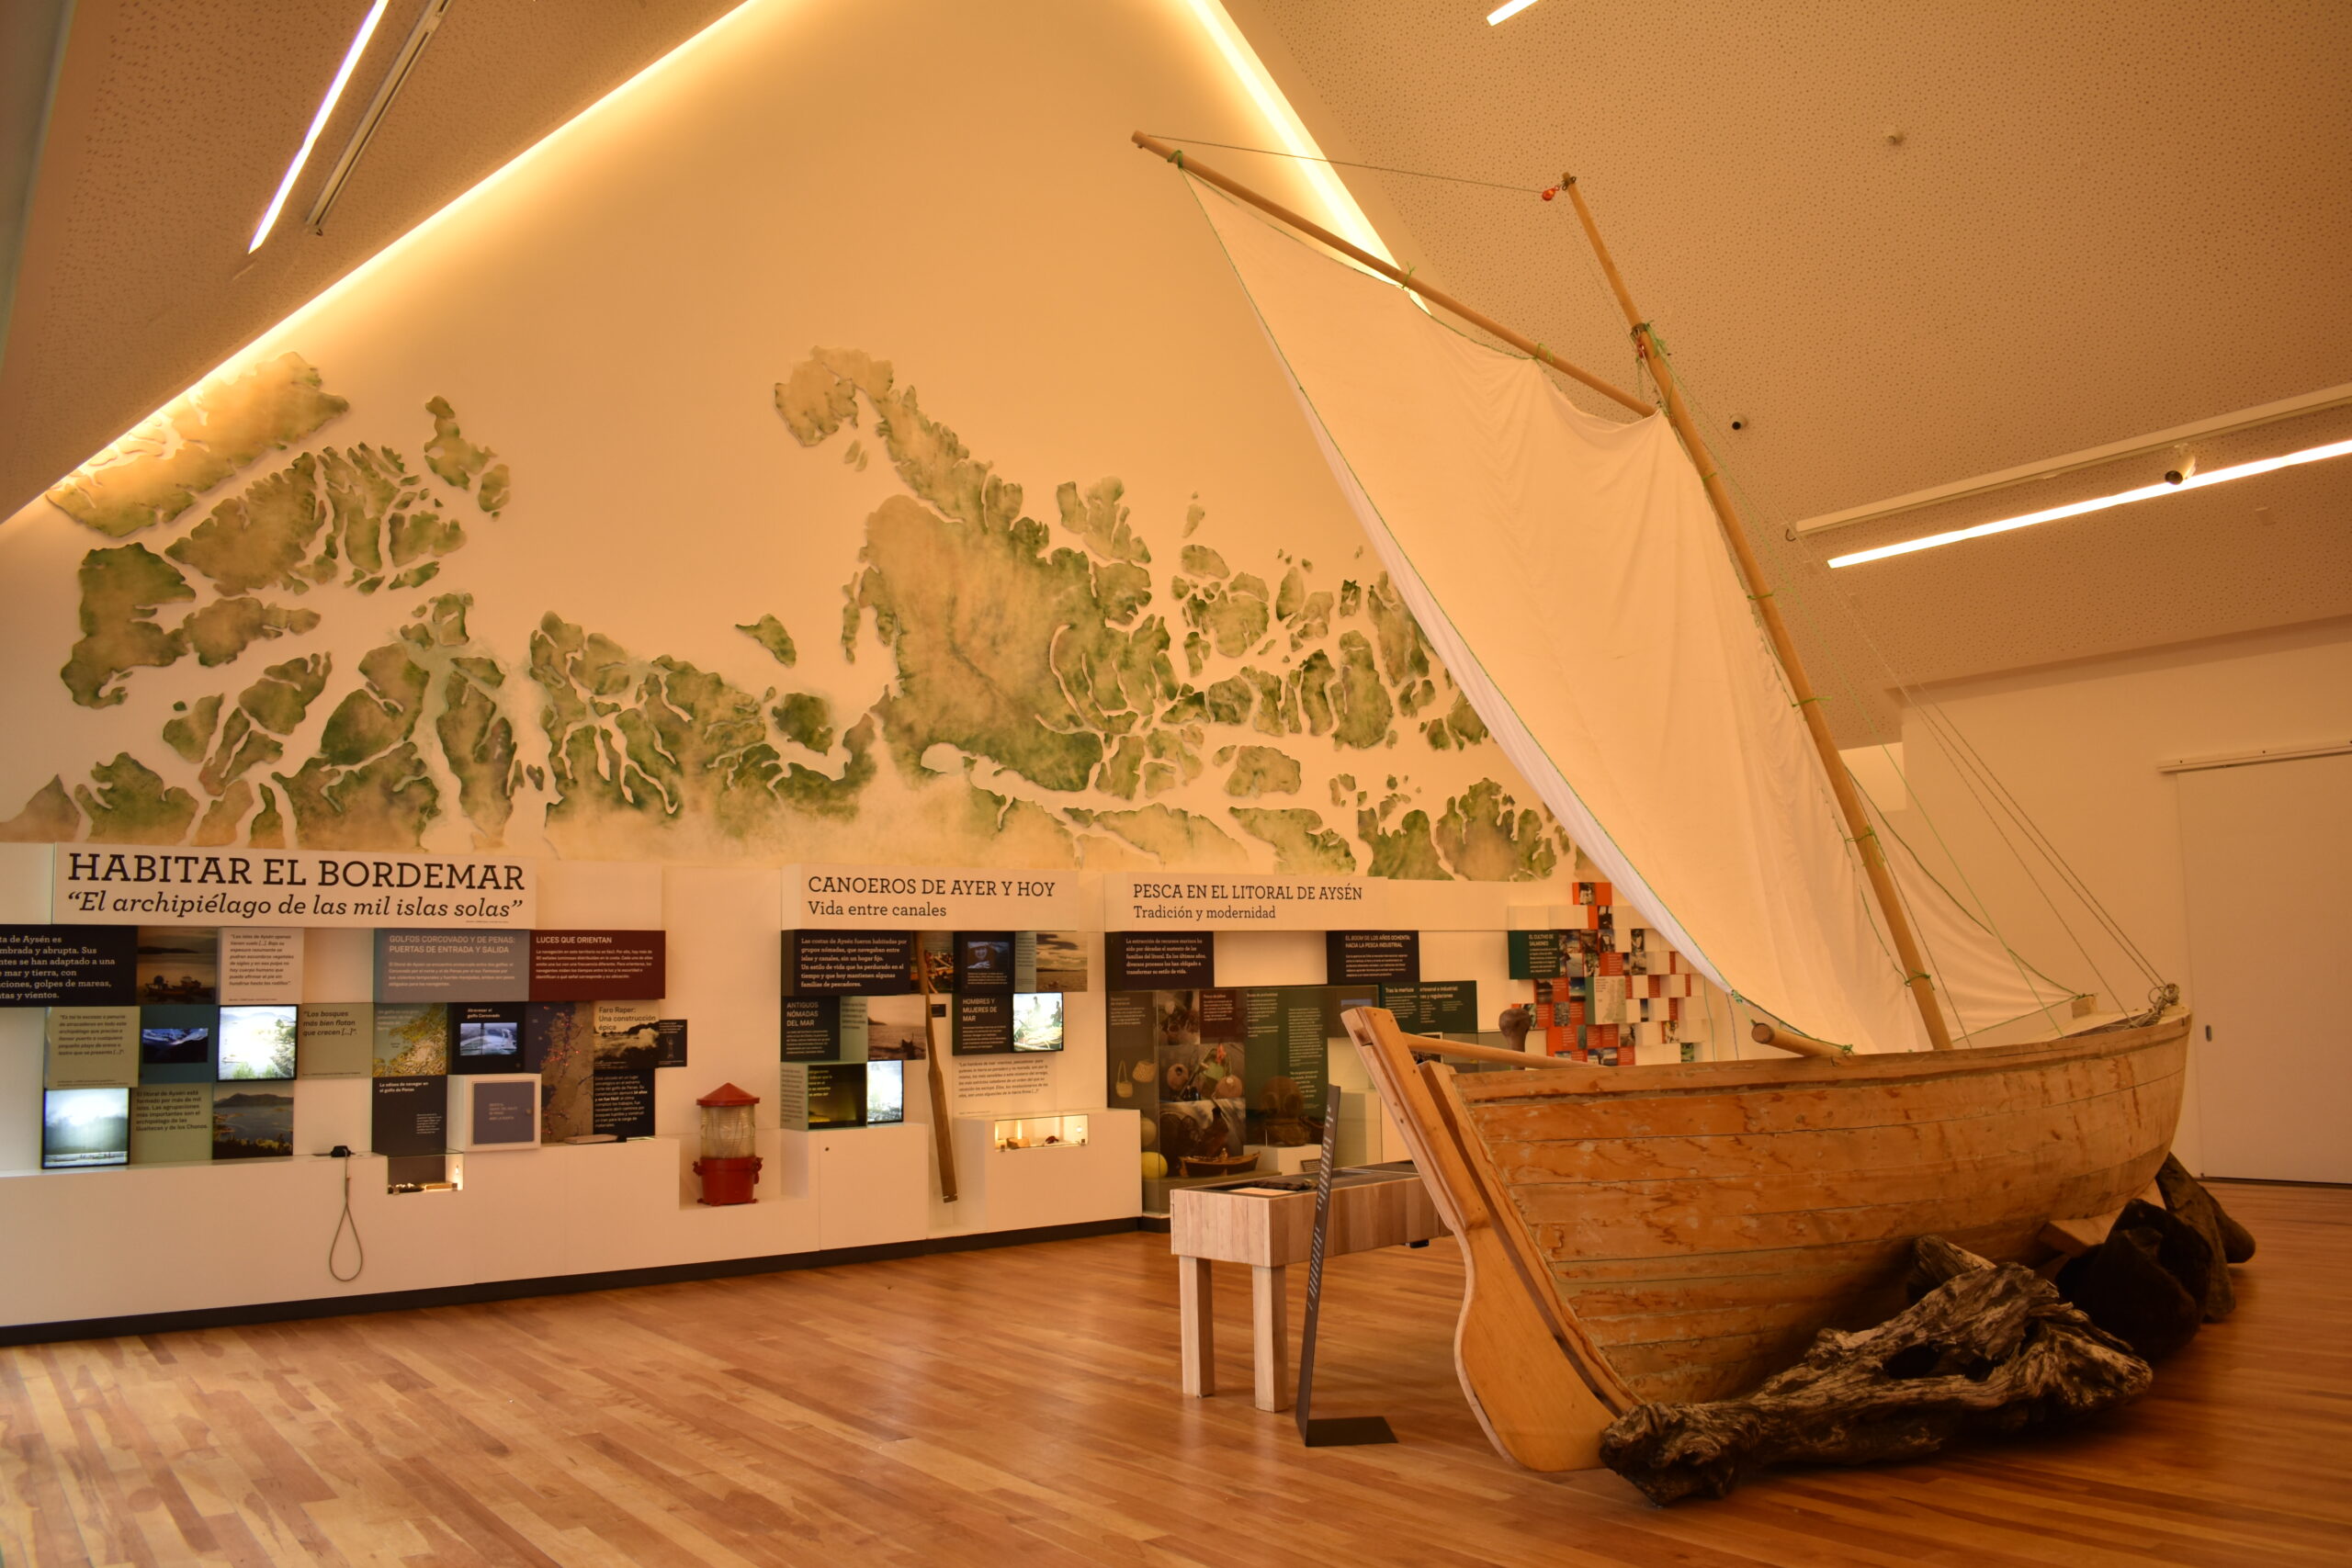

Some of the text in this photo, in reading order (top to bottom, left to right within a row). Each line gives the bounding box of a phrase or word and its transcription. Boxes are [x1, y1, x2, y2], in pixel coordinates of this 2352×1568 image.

[68, 852, 526, 890] HABITAR EL BORDEMAR
[808, 876, 1055, 897] CANOEROS DE AYER Y HOY
[1134, 883, 1363, 900] PESCA EN EL LITORAL DE AYSÉN
[68, 889, 523, 919] “El archipiélago de las mil islas solas”
[808, 900, 946, 917] Vida entre canales
[1134, 906, 1275, 921] Tradición y modernidad
[10, 935, 20, 943] de
[23, 935, 50, 945] Aysén
[390, 935, 515, 944] GOLFOS CORCOVADO Y DE PENAS:
[577, 936, 613, 944] ORIENTAN
[35, 948, 41, 956] y
[42, 946, 79, 956] abrupta.
[82, 946, 97, 954] Sus
[389, 945, 509, 954] PUERTAS DE ENTRADA Y SALIDA
[31, 957, 48, 965] han
[50, 957, 90, 967] adaptado
[24, 970, 30, 978] y
[31, 969, 59, 978] tierra,
[34, 979, 63, 989] golpes
[65, 979, 75, 987] de
[17, 992, 23, 1001] y
[25, 991, 60, 999] vientos.
[786, 1010, 819, 1018] NÓMADAS
